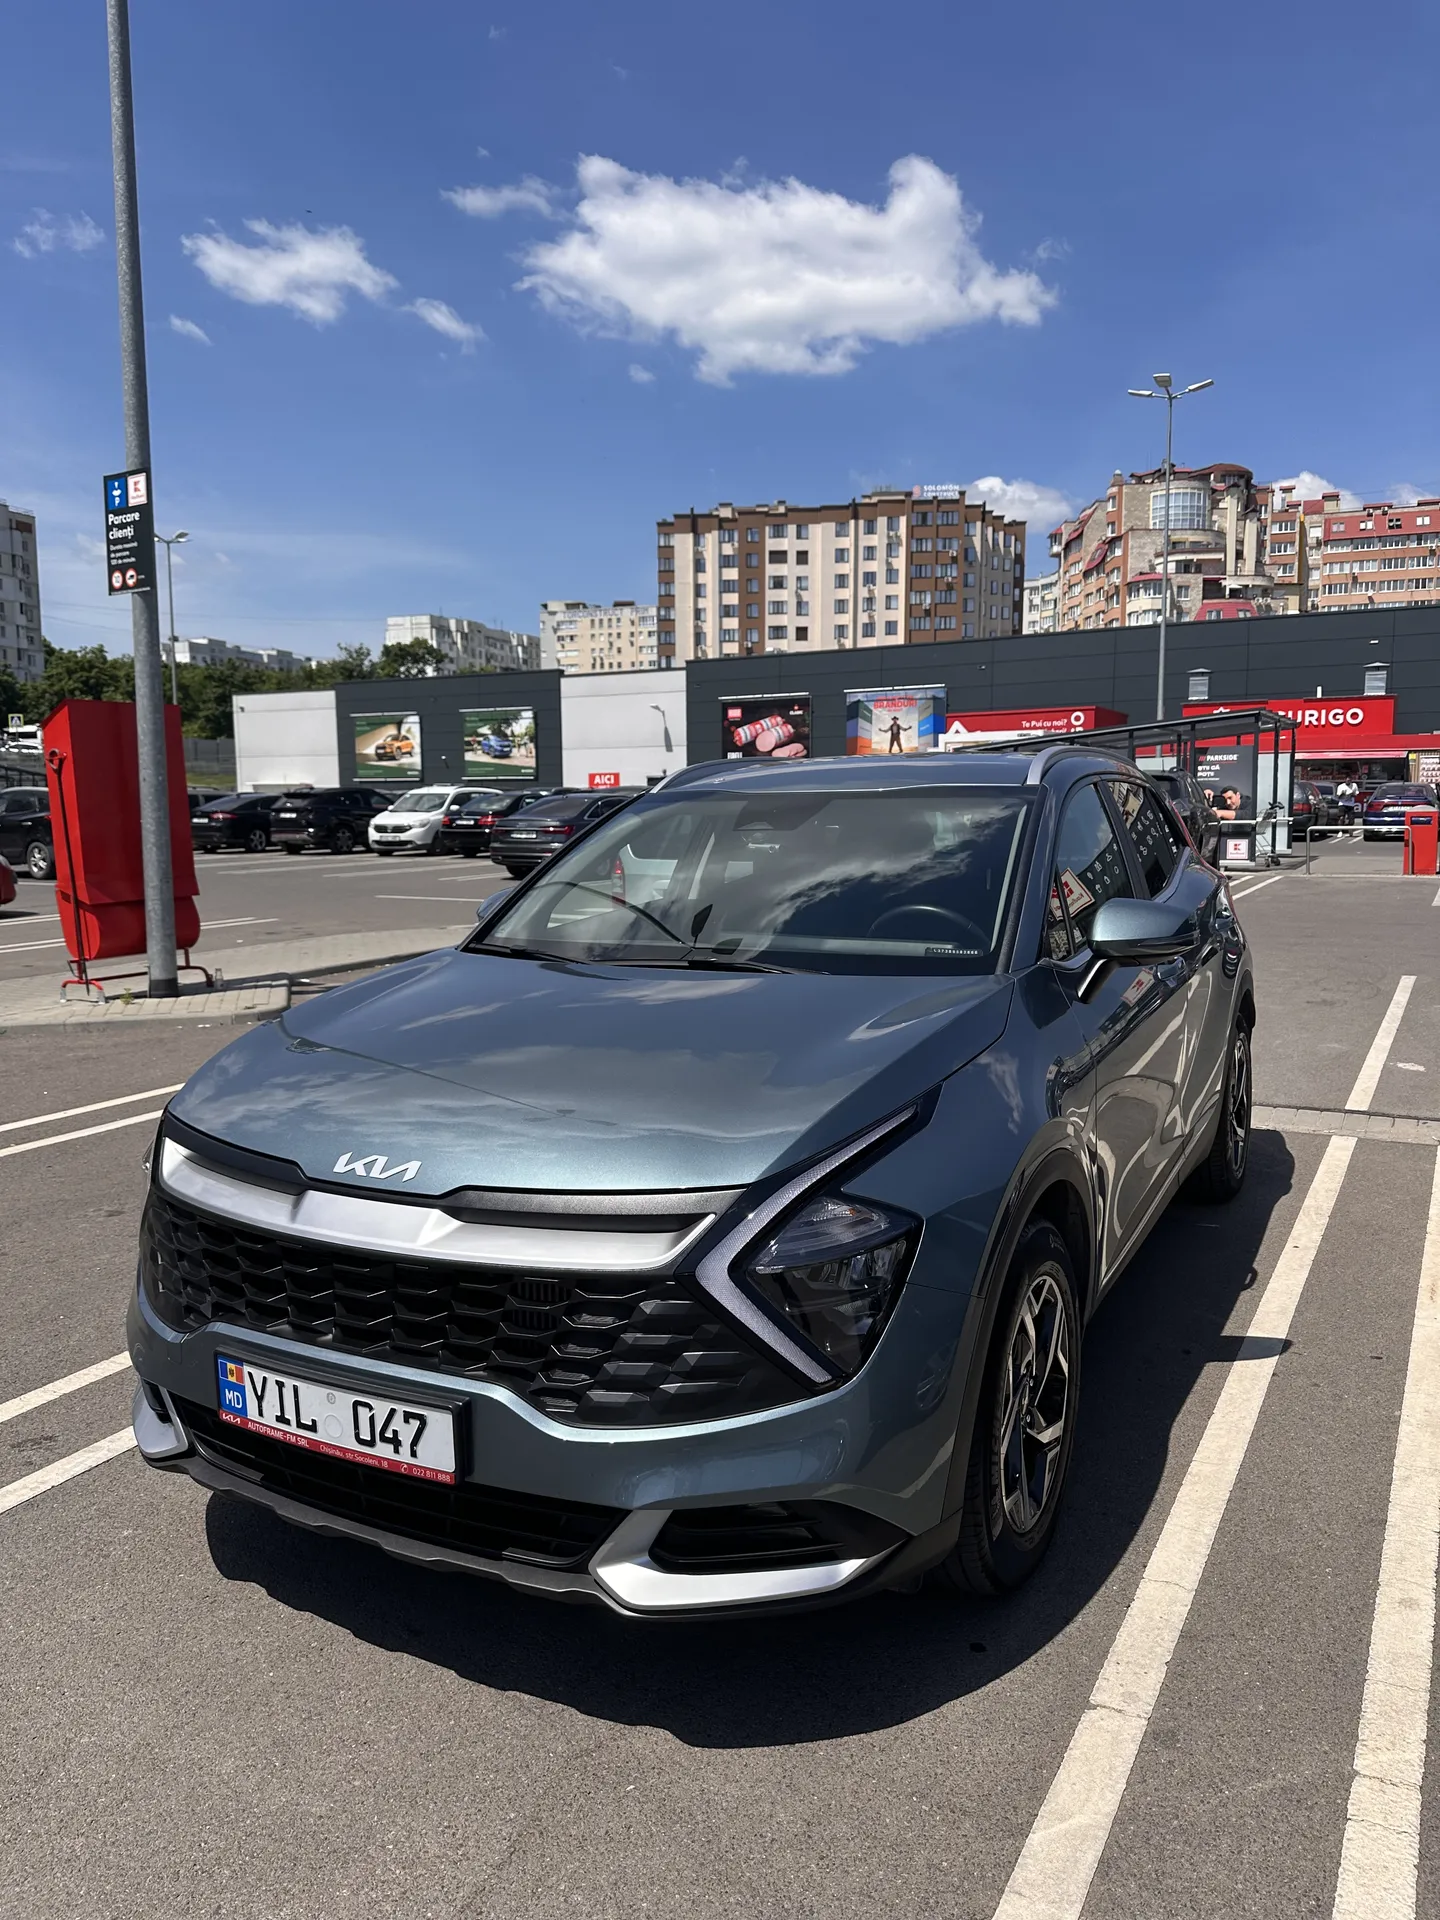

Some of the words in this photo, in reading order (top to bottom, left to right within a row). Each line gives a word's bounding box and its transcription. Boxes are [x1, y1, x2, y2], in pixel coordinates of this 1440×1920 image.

[108, 512, 140, 525] Parcare
[1021, 720, 1030, 728] Te
[1053, 718, 1067, 727] noi?
[1206, 754, 1238, 762] PARKSIDE
[594, 774, 615, 785] AICI
[333, 1152, 422, 1183] KIA
[225, 1389, 243, 1408] MD
[222, 1413, 241, 1424] KIA
[247, 1371, 318, 1434] YIL
[352, 1399, 427, 1459] 047
[247, 1421, 296, 1442] AUTOFRAME-FM
[297, 1436, 309, 1448] SRL
[381, 1460, 389, 1468] 18
[412, 1467, 425, 1477] 022
[425, 1470, 436, 1479] 811
[437, 1473, 451, 1482] 888
